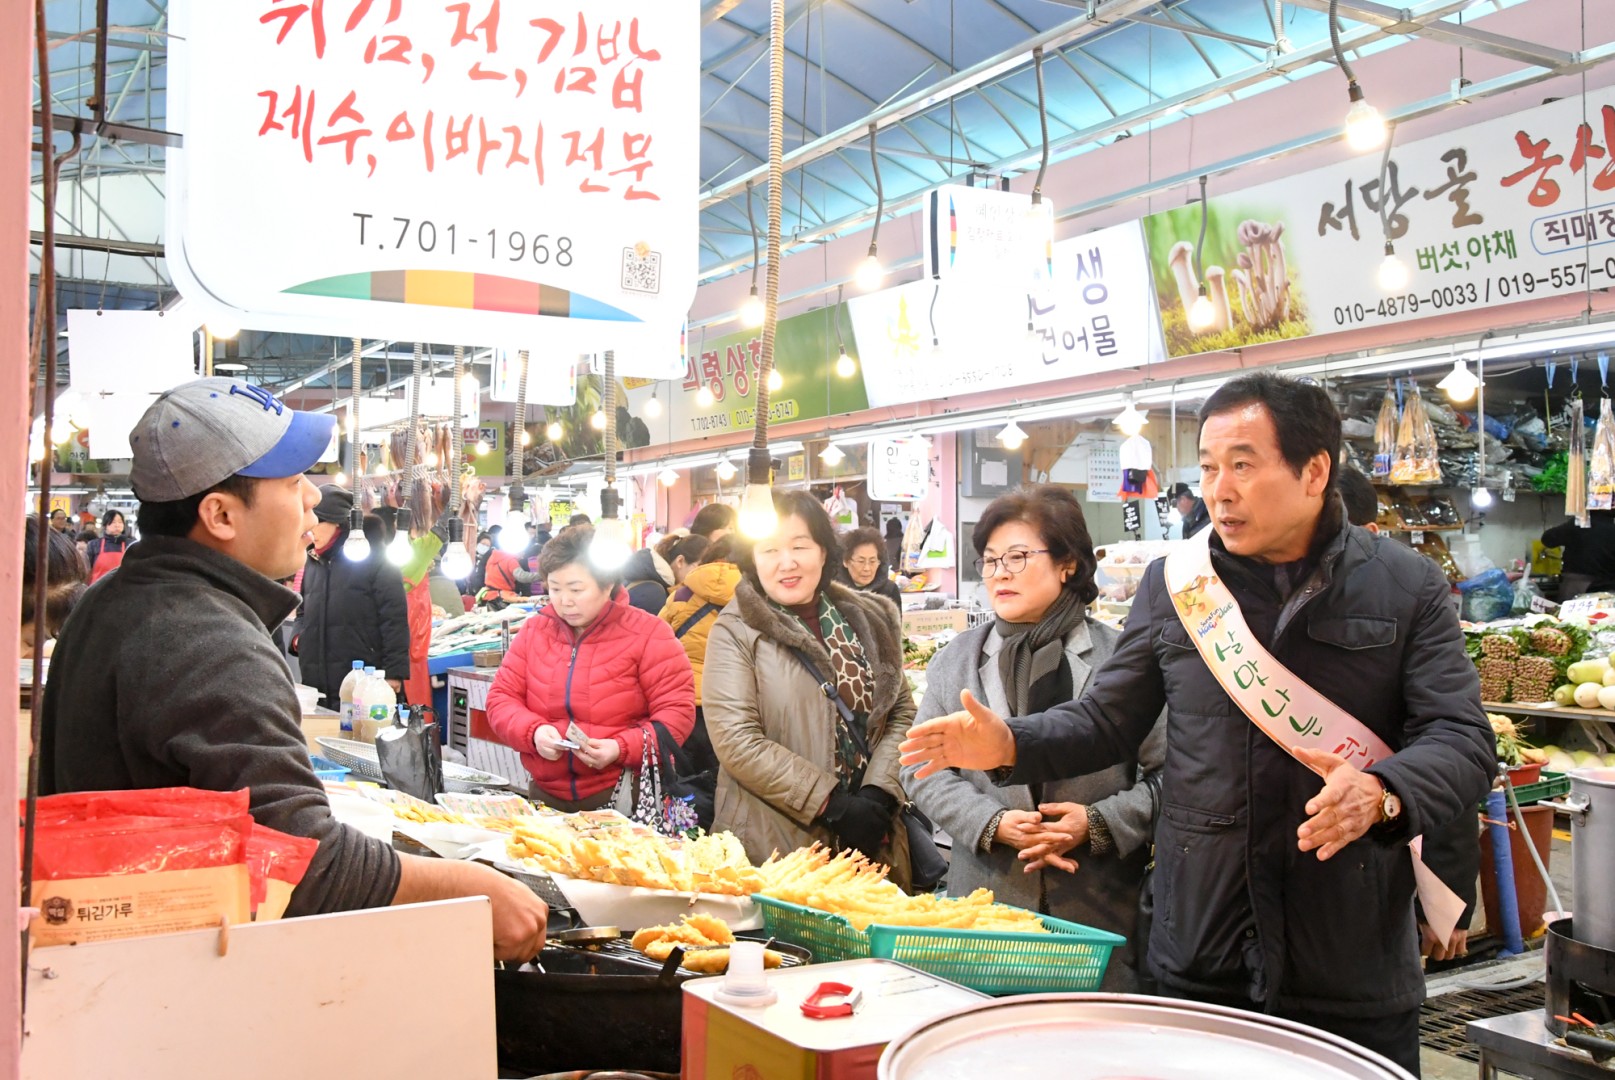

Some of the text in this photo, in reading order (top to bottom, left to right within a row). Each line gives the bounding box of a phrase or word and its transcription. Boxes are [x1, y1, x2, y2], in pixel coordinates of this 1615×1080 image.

[561, 127, 661, 200] 전문
[353, 212, 574, 267] T.701-1968
[1415, 228, 1518, 274] 버섯,야채
[1334, 282, 1478, 325] 010-4879-0033
[736, 401, 794, 425] 010--8747
[76, 902, 134, 922] 튀김가루
